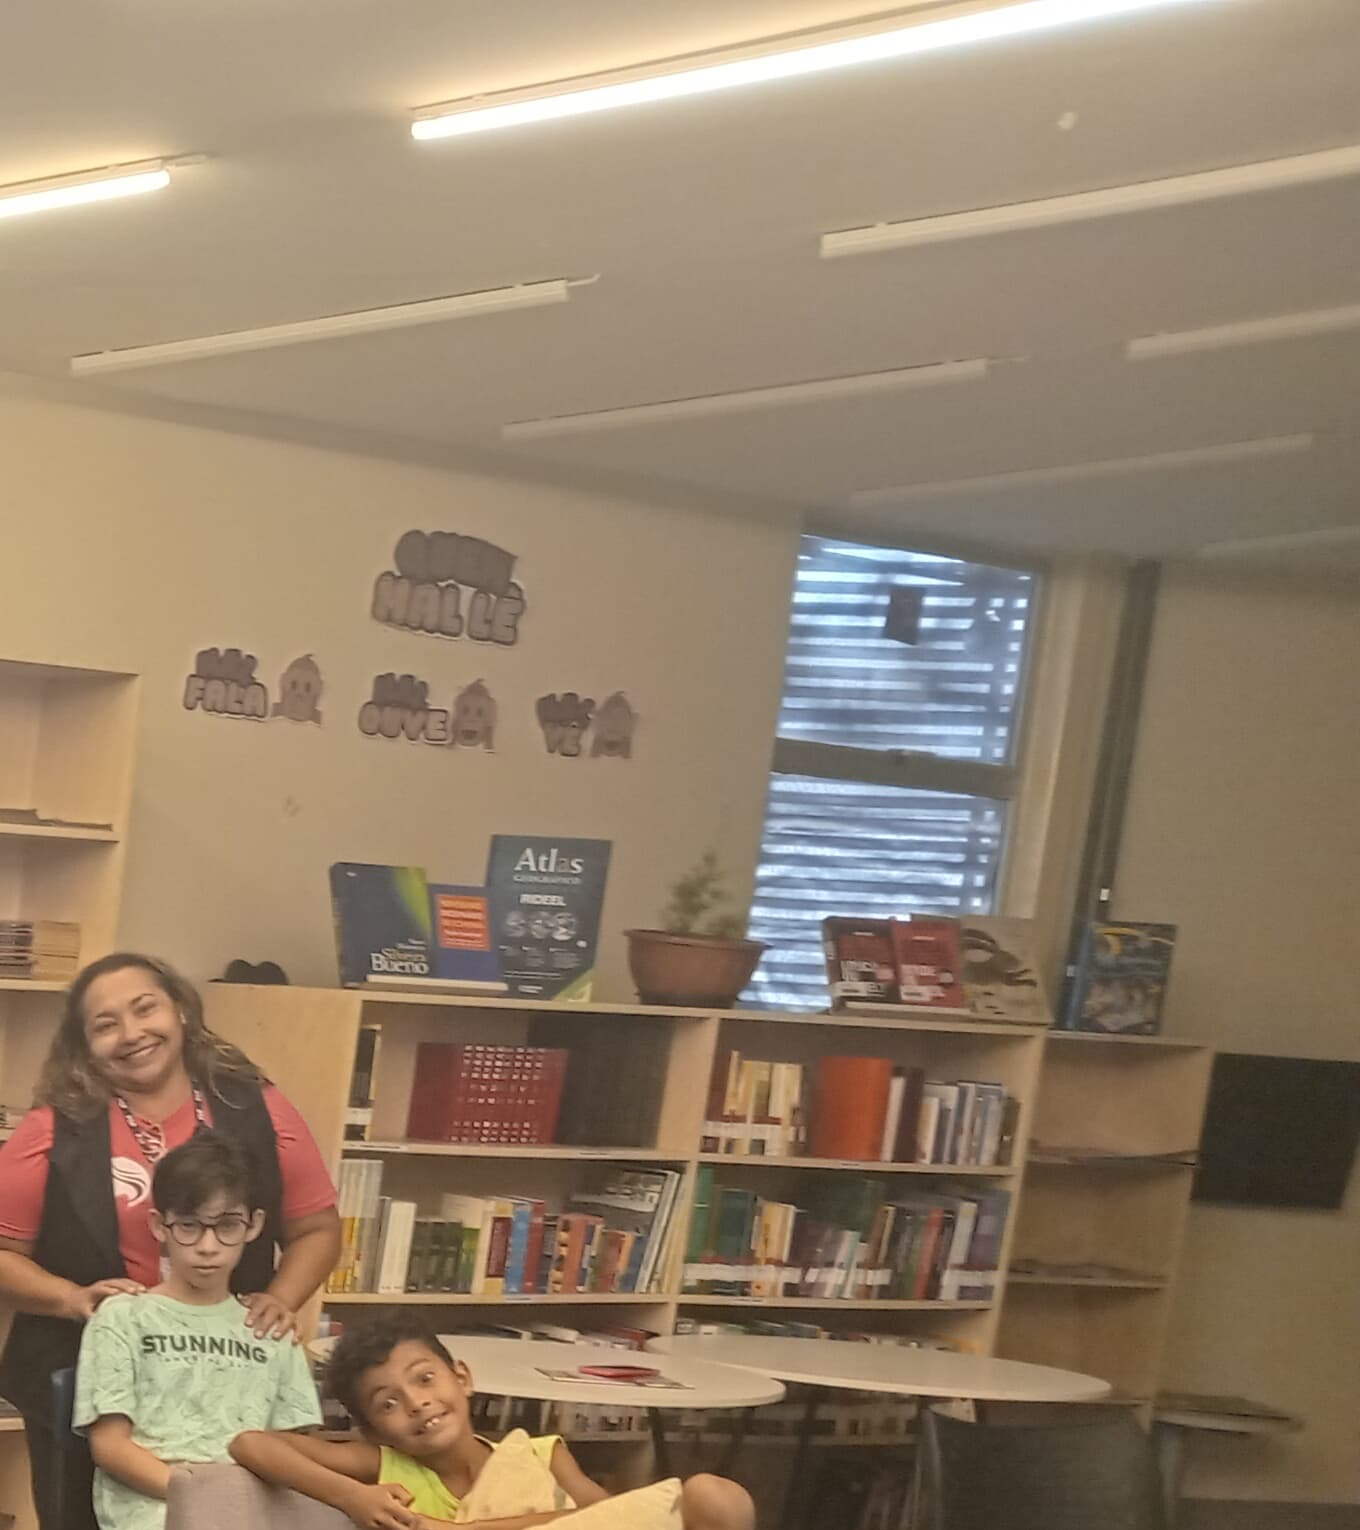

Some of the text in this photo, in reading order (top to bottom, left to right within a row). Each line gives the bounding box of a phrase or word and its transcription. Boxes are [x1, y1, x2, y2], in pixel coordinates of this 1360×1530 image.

[184, 674, 268, 718] FALA
[359, 700, 449, 742] OUVE
[513, 847, 584, 874] Atlas
[141, 1334, 268, 1364] STUNNING
